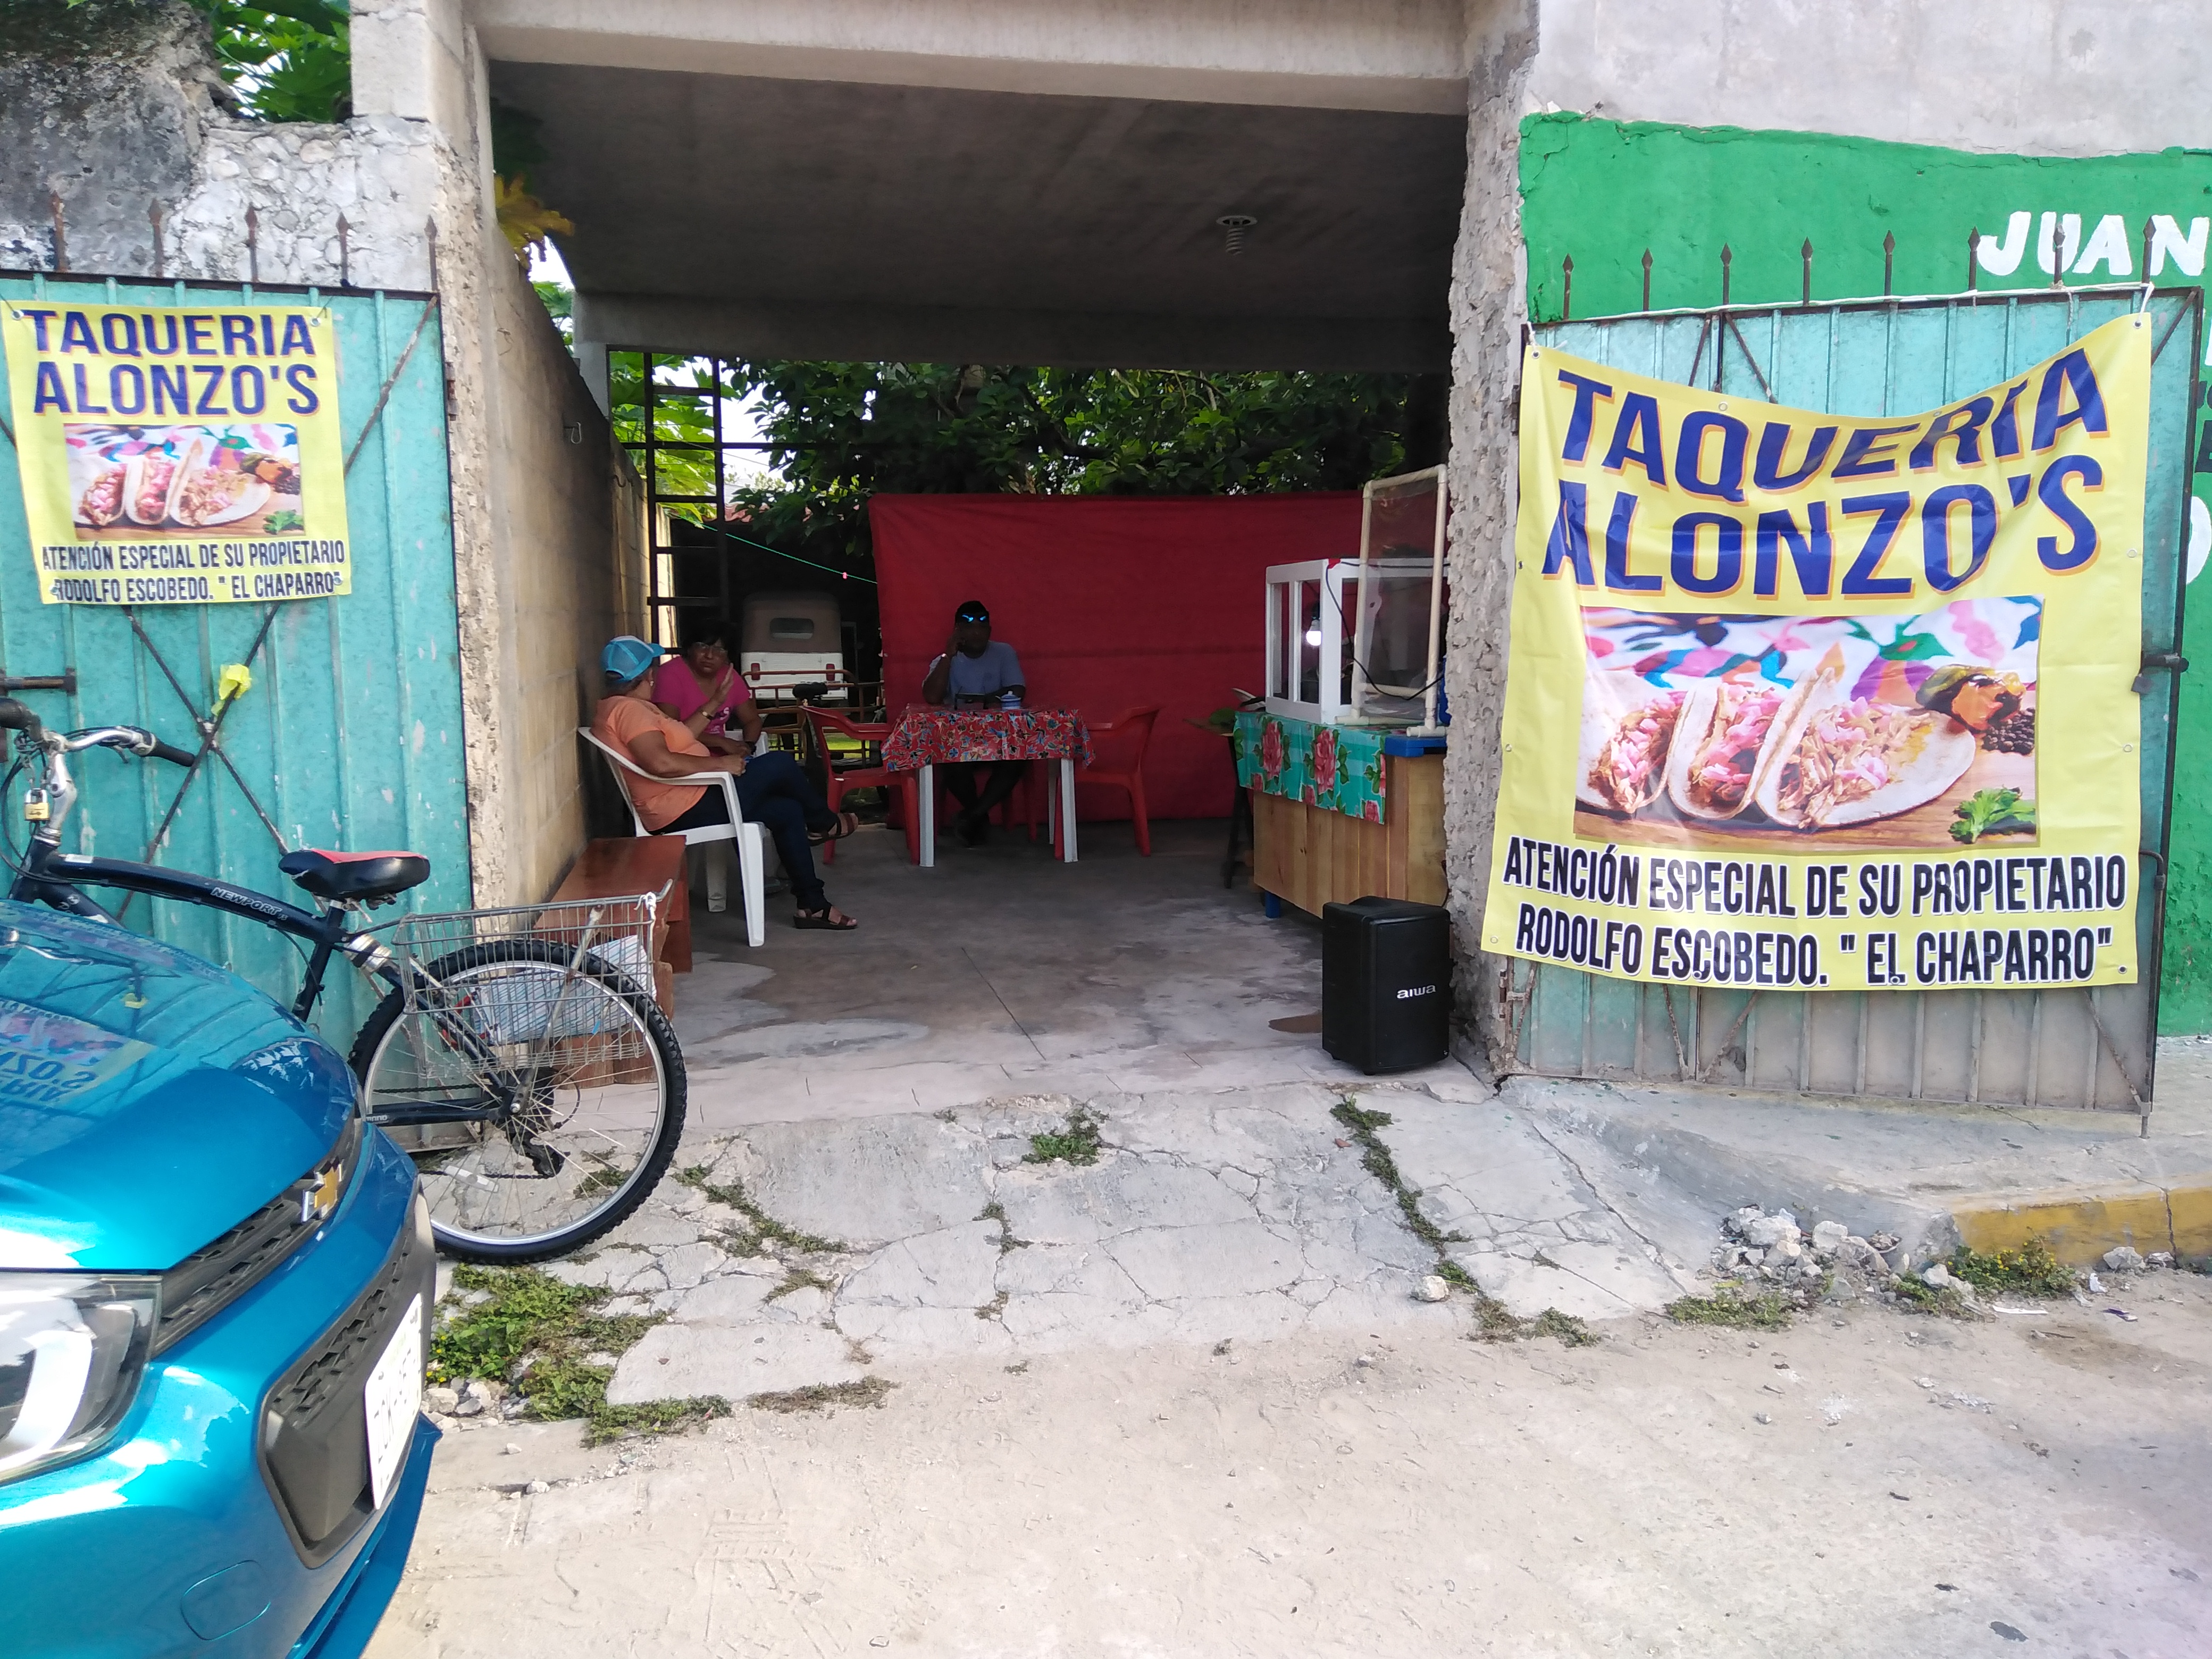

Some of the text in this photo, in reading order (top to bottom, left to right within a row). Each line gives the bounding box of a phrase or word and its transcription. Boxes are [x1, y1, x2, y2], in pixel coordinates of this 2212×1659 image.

[1977, 211, 2209, 275] JUAN
[21, 309, 316, 358] TAQUERIA
[33, 361, 320, 416] ALONZO'S
[1556, 347, 2109, 504] TAQUERIA
[1541, 454, 2104, 600] ALONZO'S
[43, 540, 346, 570] ATENCIÓN ESPECIAL DE SU PROPIETARIO
[54, 579, 121, 602] RODOLFO
[125, 576, 214, 602] ESCOBEDO.
[231, 575, 250, 599] EL
[211, 887, 283, 916] NEWPORT
[1503, 836, 2126, 918] ATENCIÓN ESPECIAL DE SU PROPIETARIO
[1516, 903, 1644, 975] RODOLFO
[1652, 926, 1829, 987] ESCOBEDO.
[1867, 933, 1907, 985] EL
[1916, 926, 2113, 984] CHAPARRO"
[1397, 985, 1436, 999] aiwa
